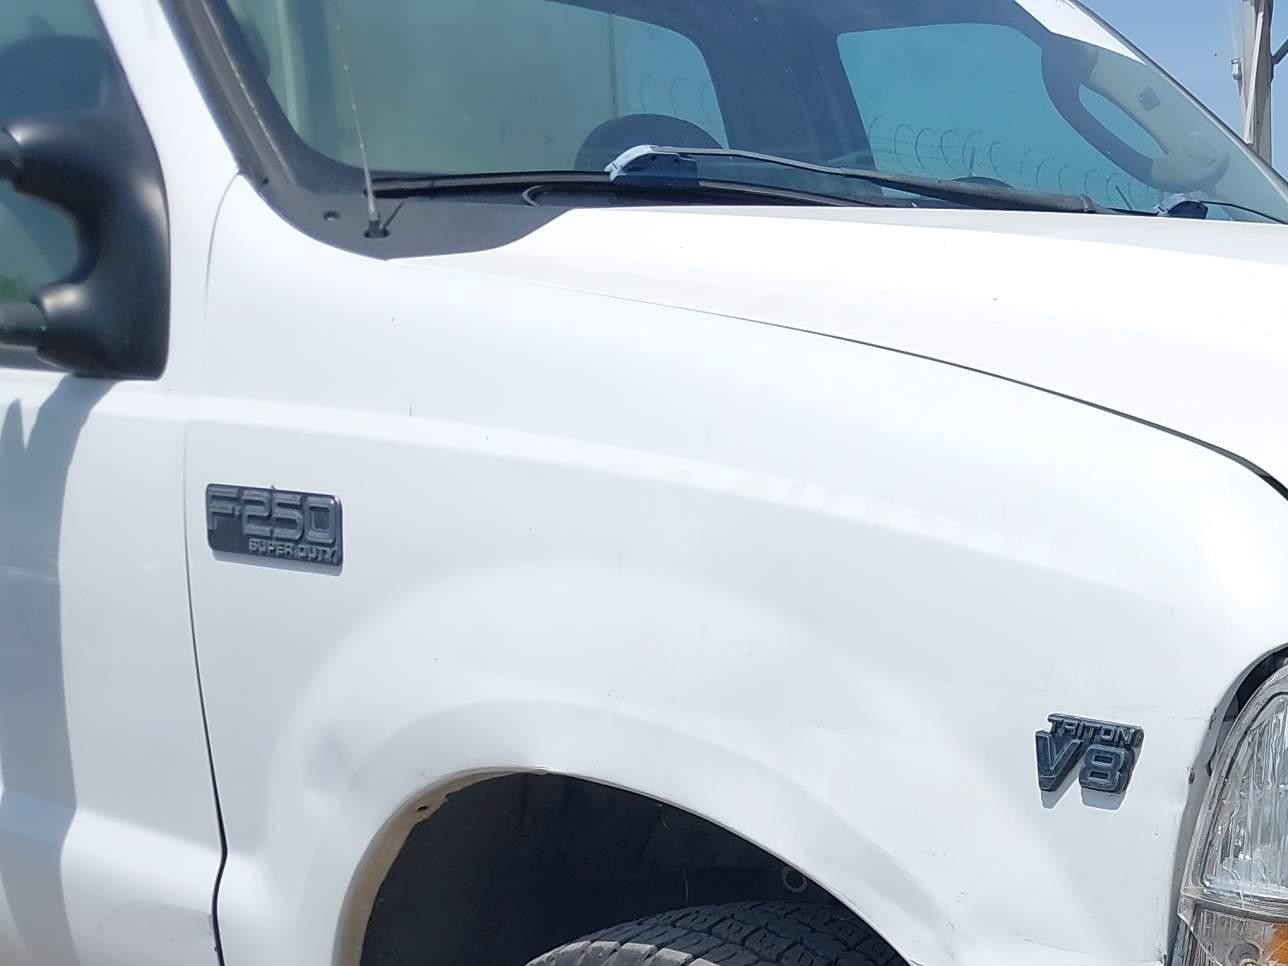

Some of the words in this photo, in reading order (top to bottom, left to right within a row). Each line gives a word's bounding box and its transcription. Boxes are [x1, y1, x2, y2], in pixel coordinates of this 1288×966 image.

[248, 538, 295, 559] SUPER
[298, 544, 338, 563] DUTY
[1036, 731, 1130, 793] V8
